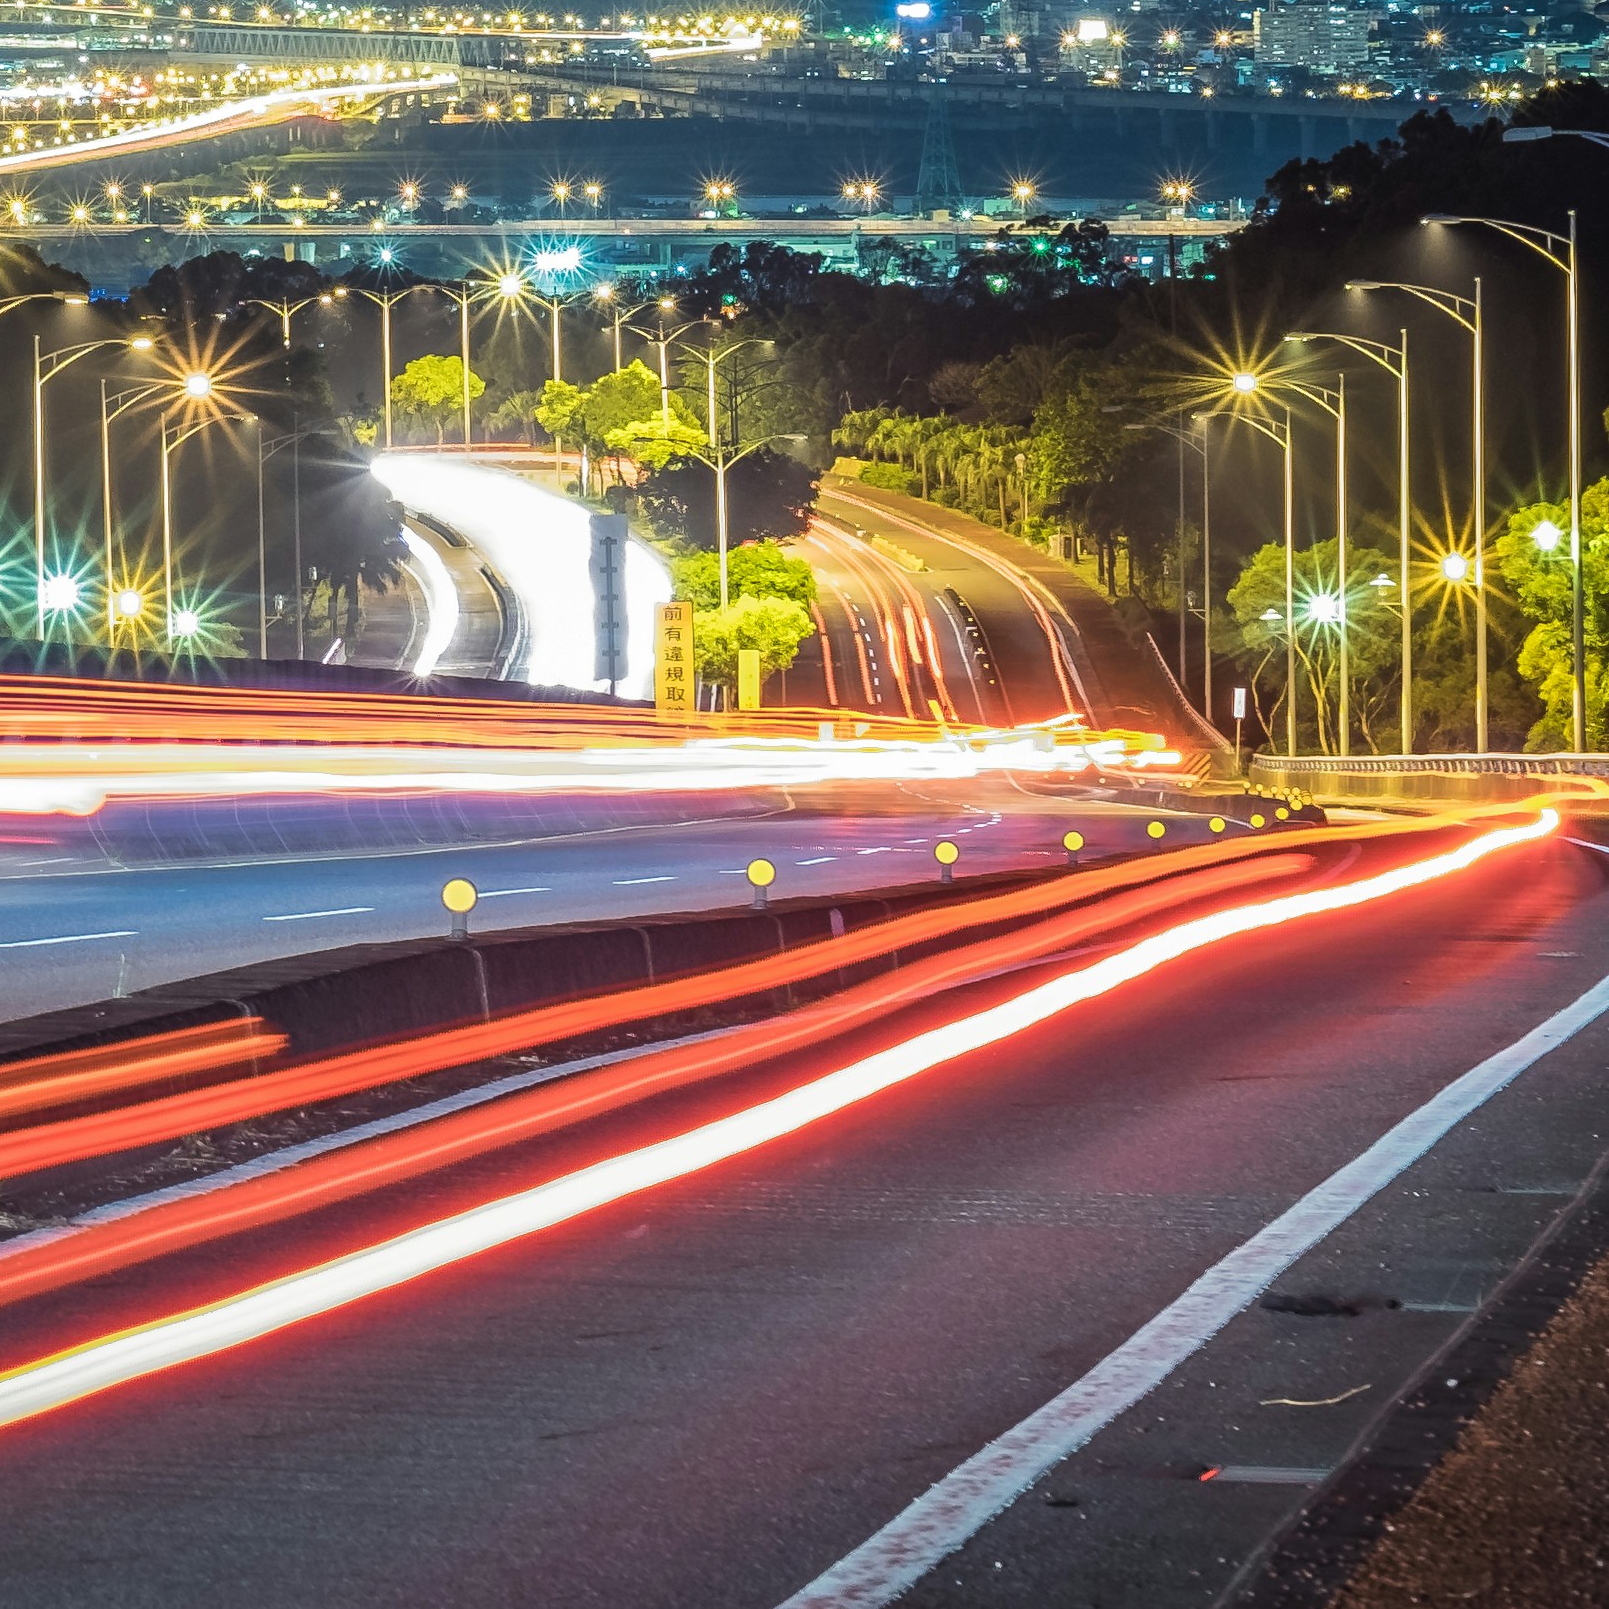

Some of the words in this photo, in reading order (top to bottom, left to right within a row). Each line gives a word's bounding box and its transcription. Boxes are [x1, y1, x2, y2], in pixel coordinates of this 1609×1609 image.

[663, 606, 685, 714] 前有違規取
